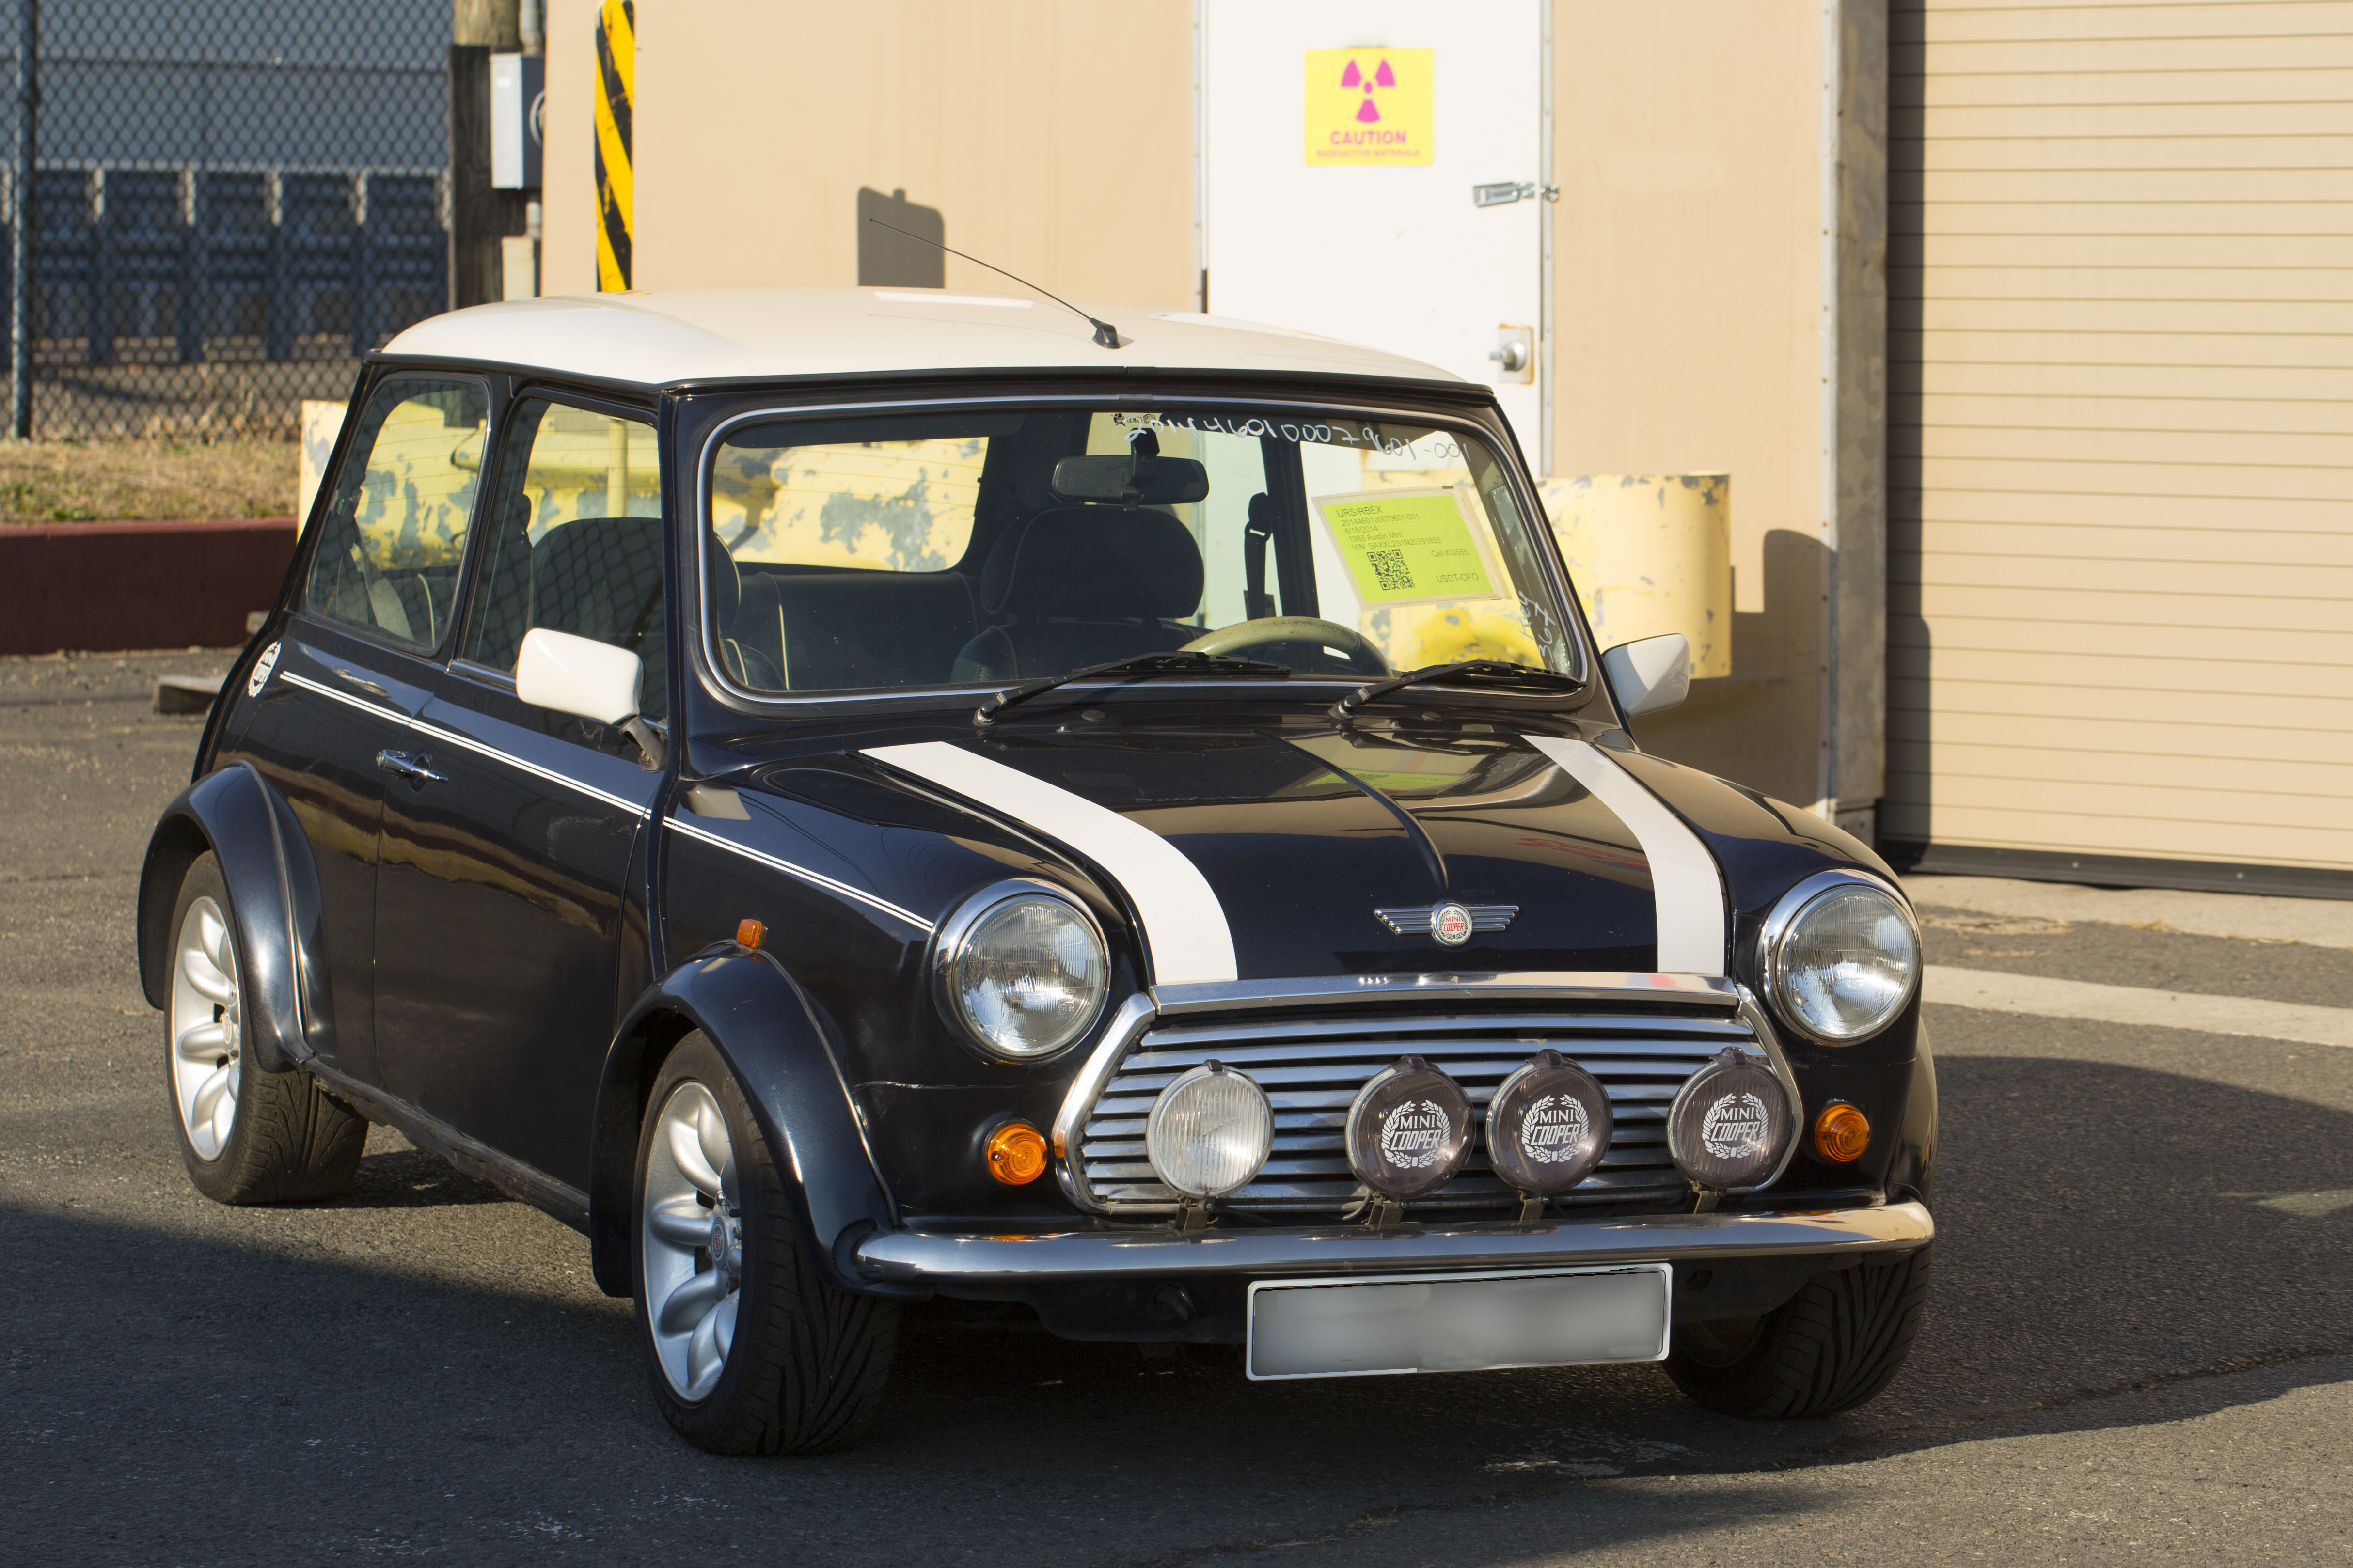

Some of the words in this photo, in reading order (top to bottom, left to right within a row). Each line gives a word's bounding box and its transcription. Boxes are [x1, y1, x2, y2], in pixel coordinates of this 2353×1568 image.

[1330, 130, 1406, 145] CAUTION
[1336, 505, 1383, 517] URS/RBEX
[1341, 513, 1420, 527] 2014460100079601-001
[1344, 525, 1378, 535] 6/18/2014
[1367, 533, 1388, 541] Austin
[1436, 573, 1479, 583] USDT-OFO
[1443, 922, 1464, 932] COOPER
[1539, 1109, 1574, 1124] MINI
[1721, 1107, 1754, 1121] MINI
[1399, 1114, 1436, 1129] MINI
[1530, 1124, 1580, 1145] COOPER
[1710, 1121, 1761, 1142] COOPER
[1390, 1130, 1442, 1151] COOPER
